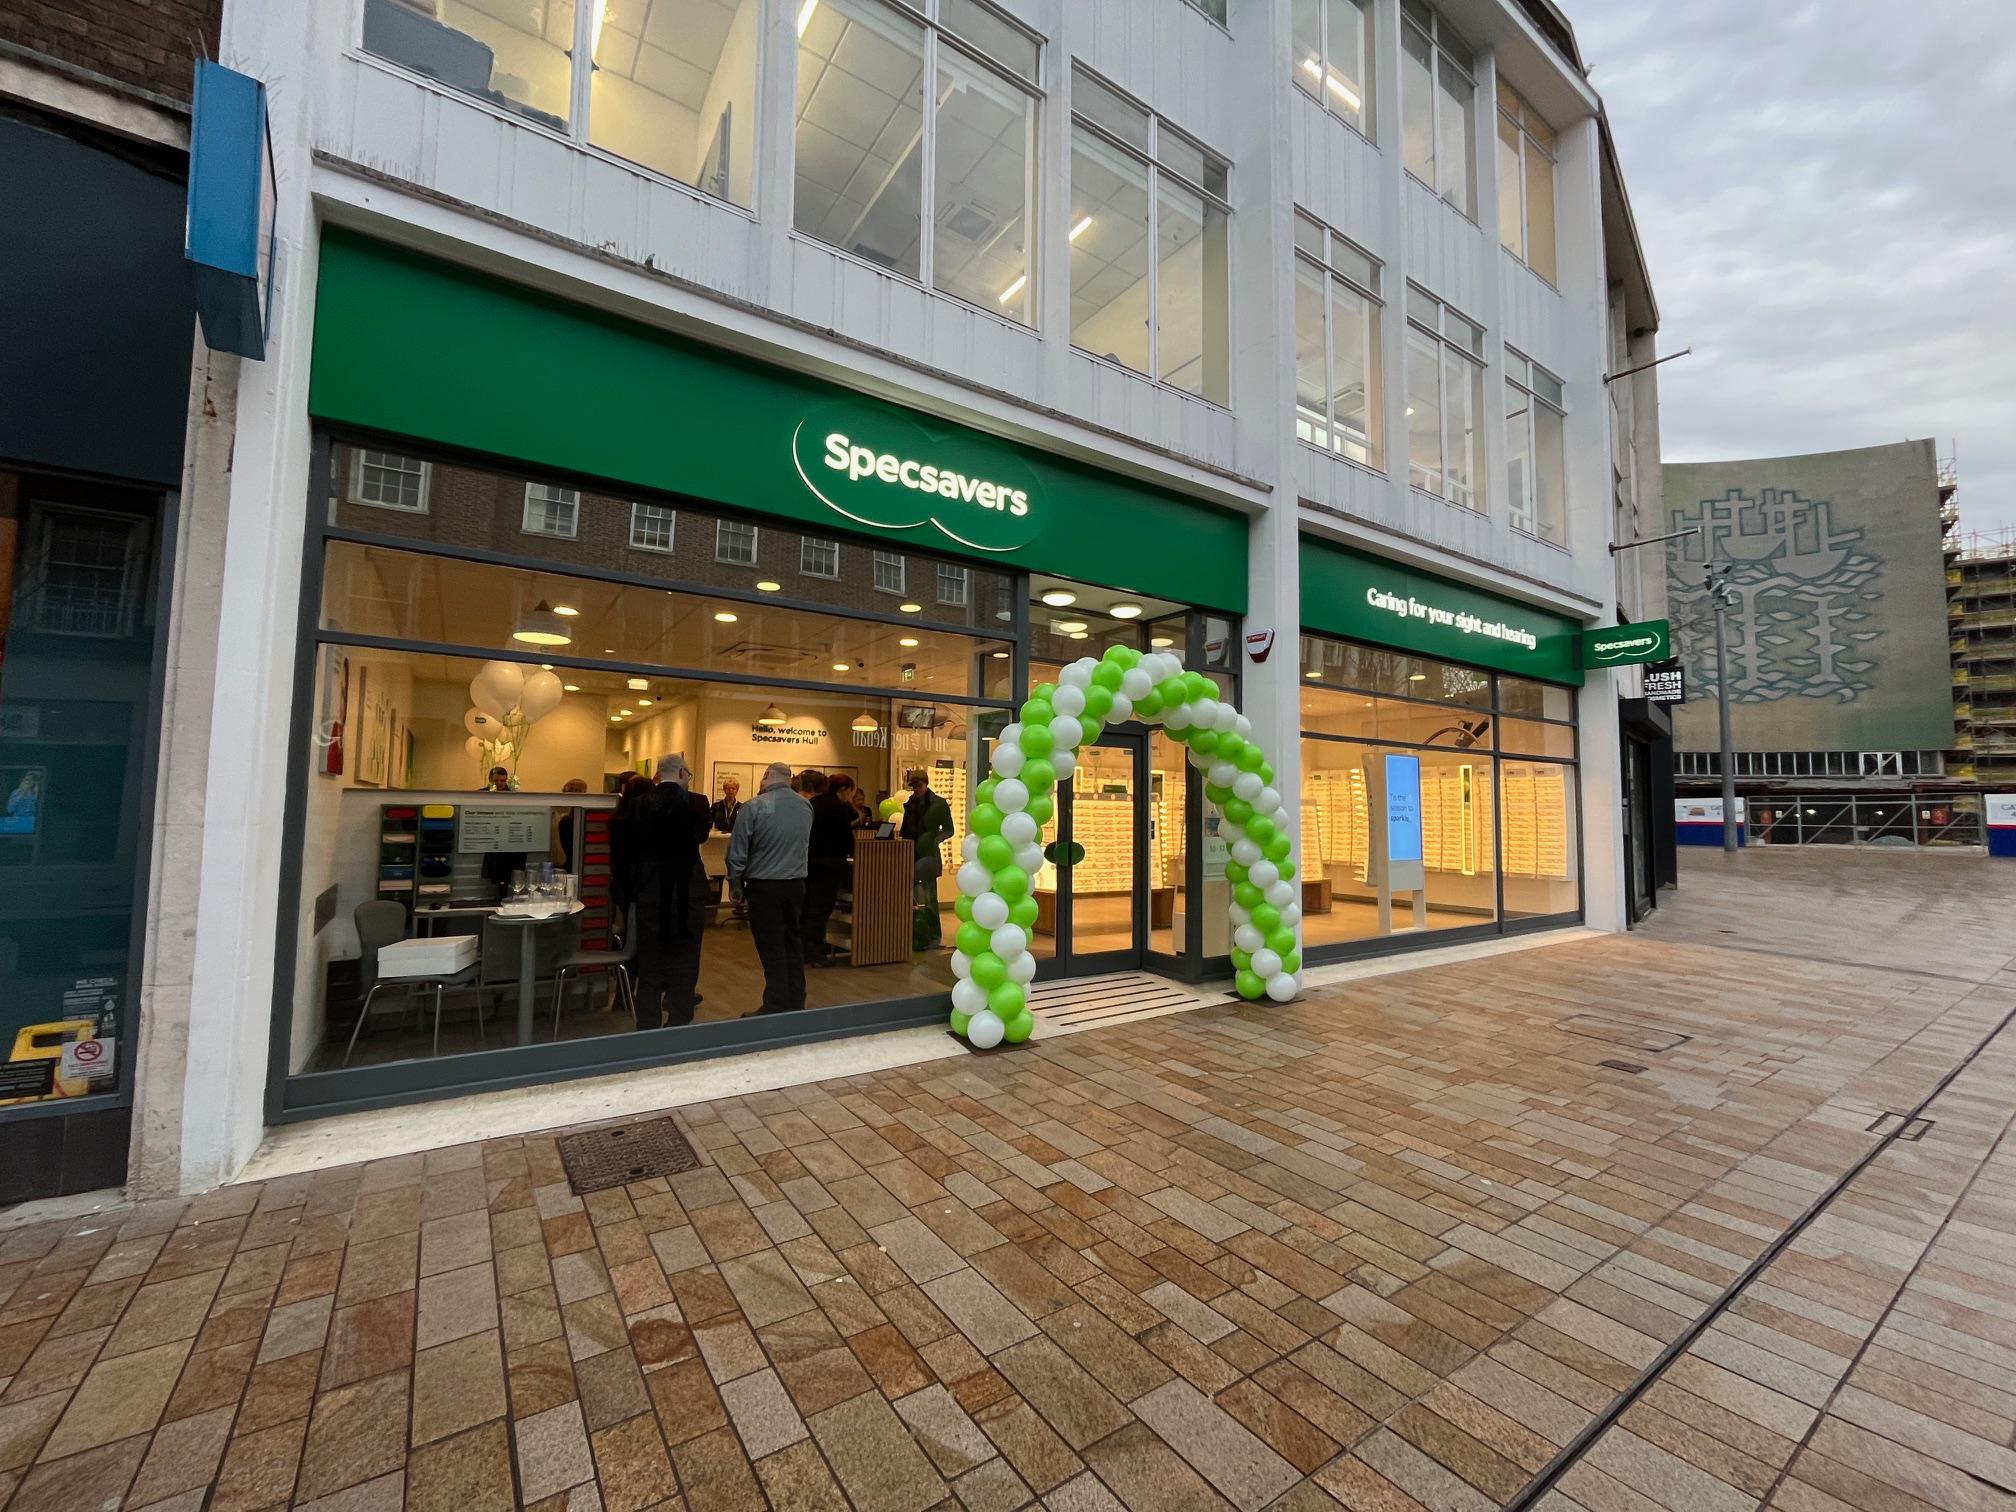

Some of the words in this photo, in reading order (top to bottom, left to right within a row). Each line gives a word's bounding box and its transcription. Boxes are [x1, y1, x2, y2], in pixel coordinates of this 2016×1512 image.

[824, 433, 1029, 517] Specsavers
[1366, 587, 1408, 617] Caring
[1408, 597, 1428, 618] for
[1427, 606, 1455, 624] your
[1455, 612, 1483, 633] sight
[1482, 622, 1501, 638] and
[1501, 623, 1537, 650] hearing
[1593, 637, 1653, 652] Specsavers
[751, 725, 776, 734] Hello,
[778, 726, 815, 736] welcome
[817, 729, 827, 737] to
[751, 733, 800, 744] Specsavers
[802, 735, 819, 745] Hull
